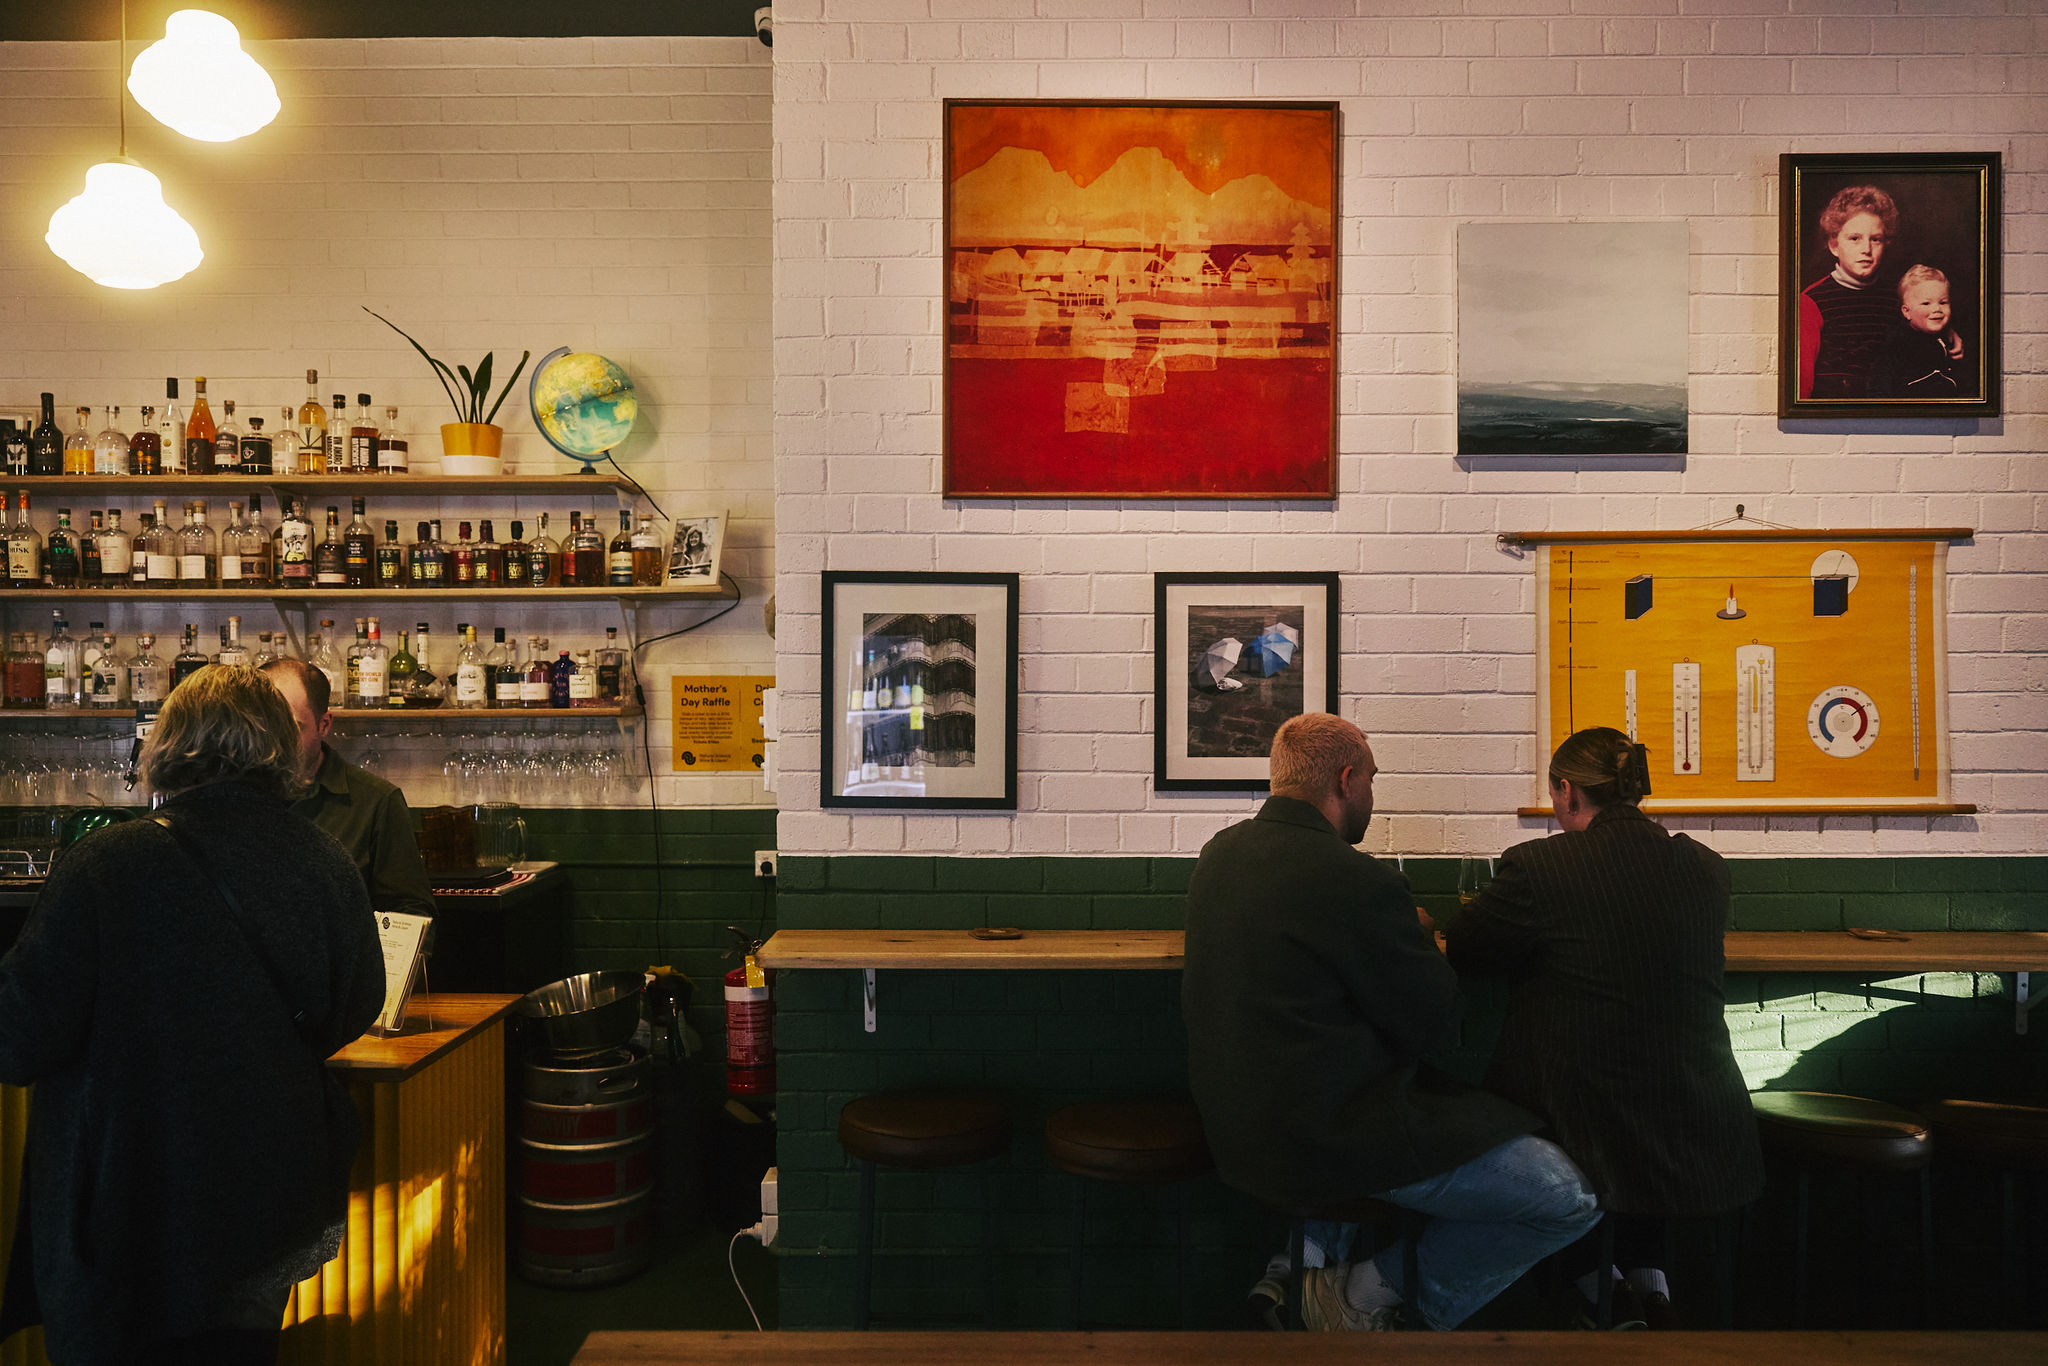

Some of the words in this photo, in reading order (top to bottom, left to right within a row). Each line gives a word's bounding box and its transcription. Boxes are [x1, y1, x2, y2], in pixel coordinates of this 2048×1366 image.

[684, 684, 728, 693] Mother's
[681, 698, 700, 708] Day
[702, 697, 731, 706] Raffle
